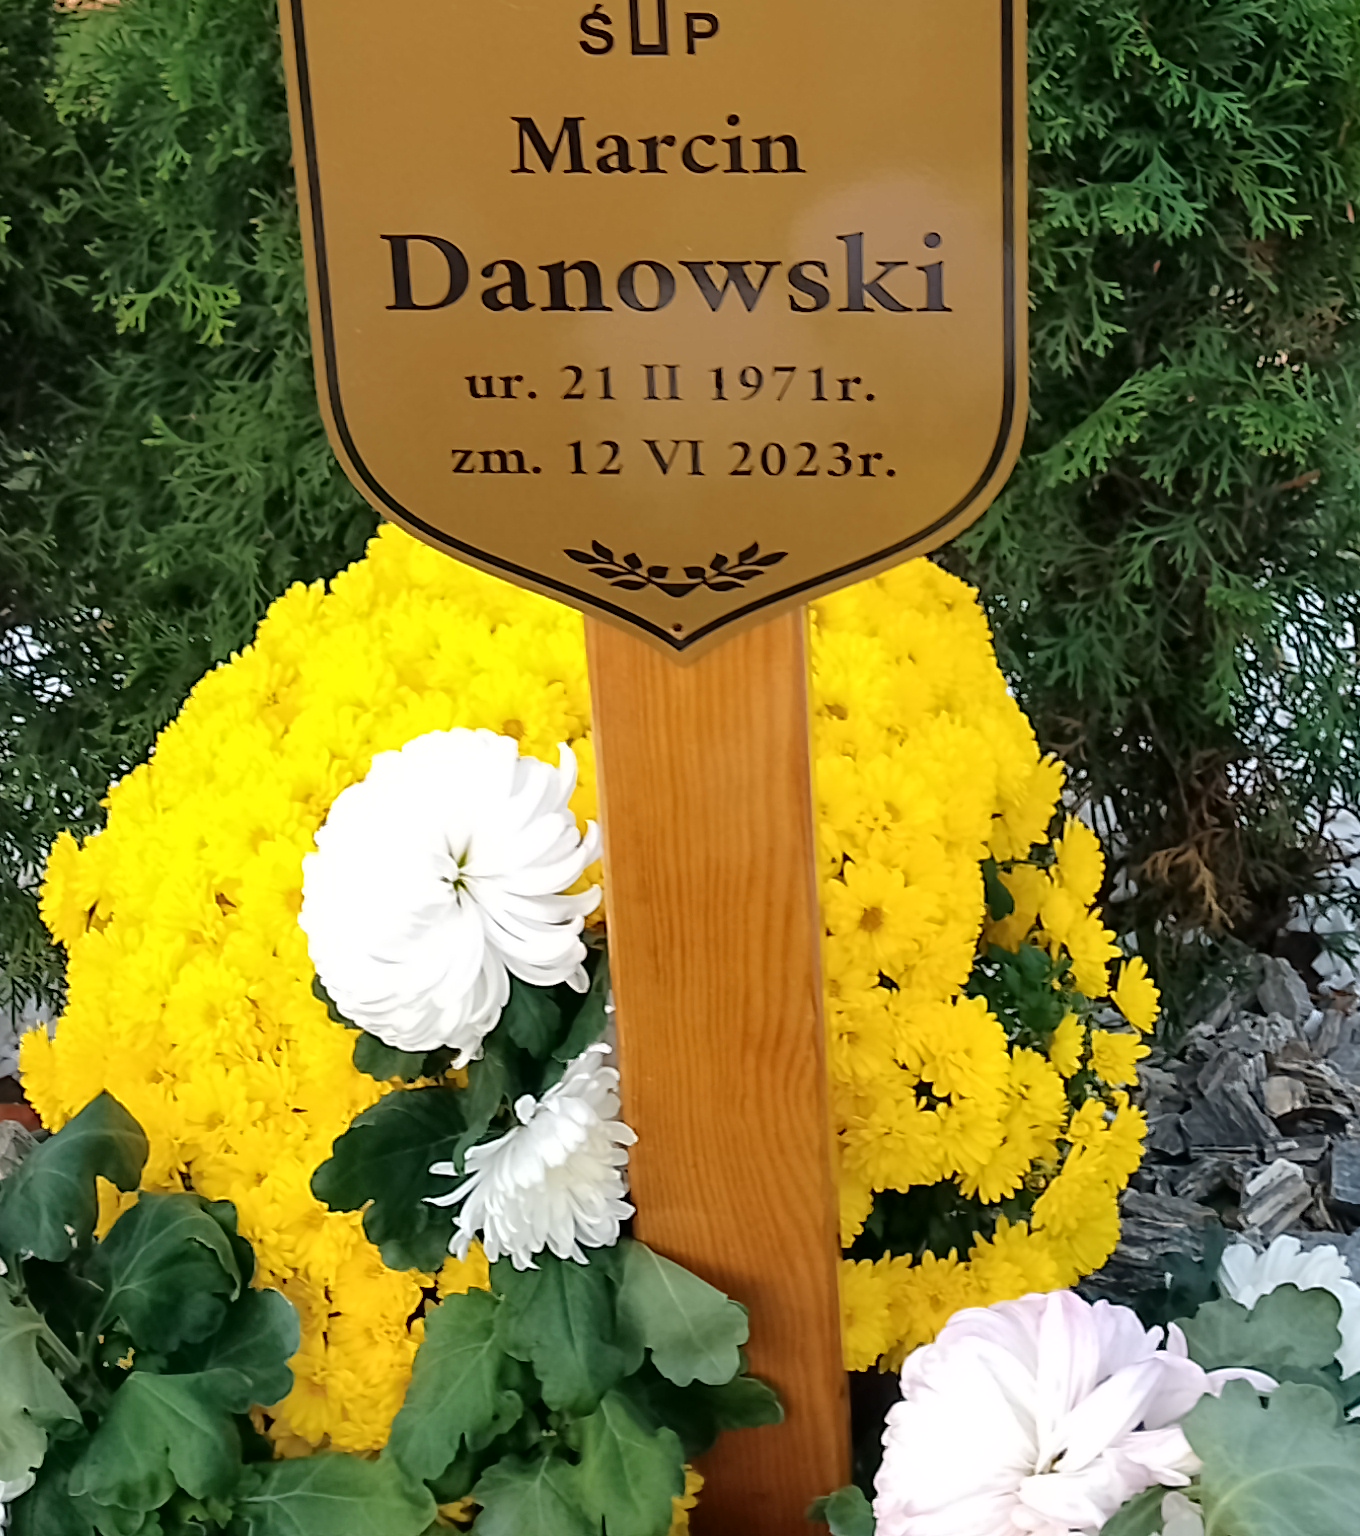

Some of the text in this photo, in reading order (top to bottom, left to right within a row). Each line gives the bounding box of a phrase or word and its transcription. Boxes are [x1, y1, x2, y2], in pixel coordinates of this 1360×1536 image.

[579, 4, 720, 56] Ś P
[509, 113, 808, 175] Marcin
[379, 231, 953, 313] Danowski
[464, 364, 876, 402] ur. 21 II 1971r.
[451, 439, 898, 478] zm. 12 VI 2023r.
